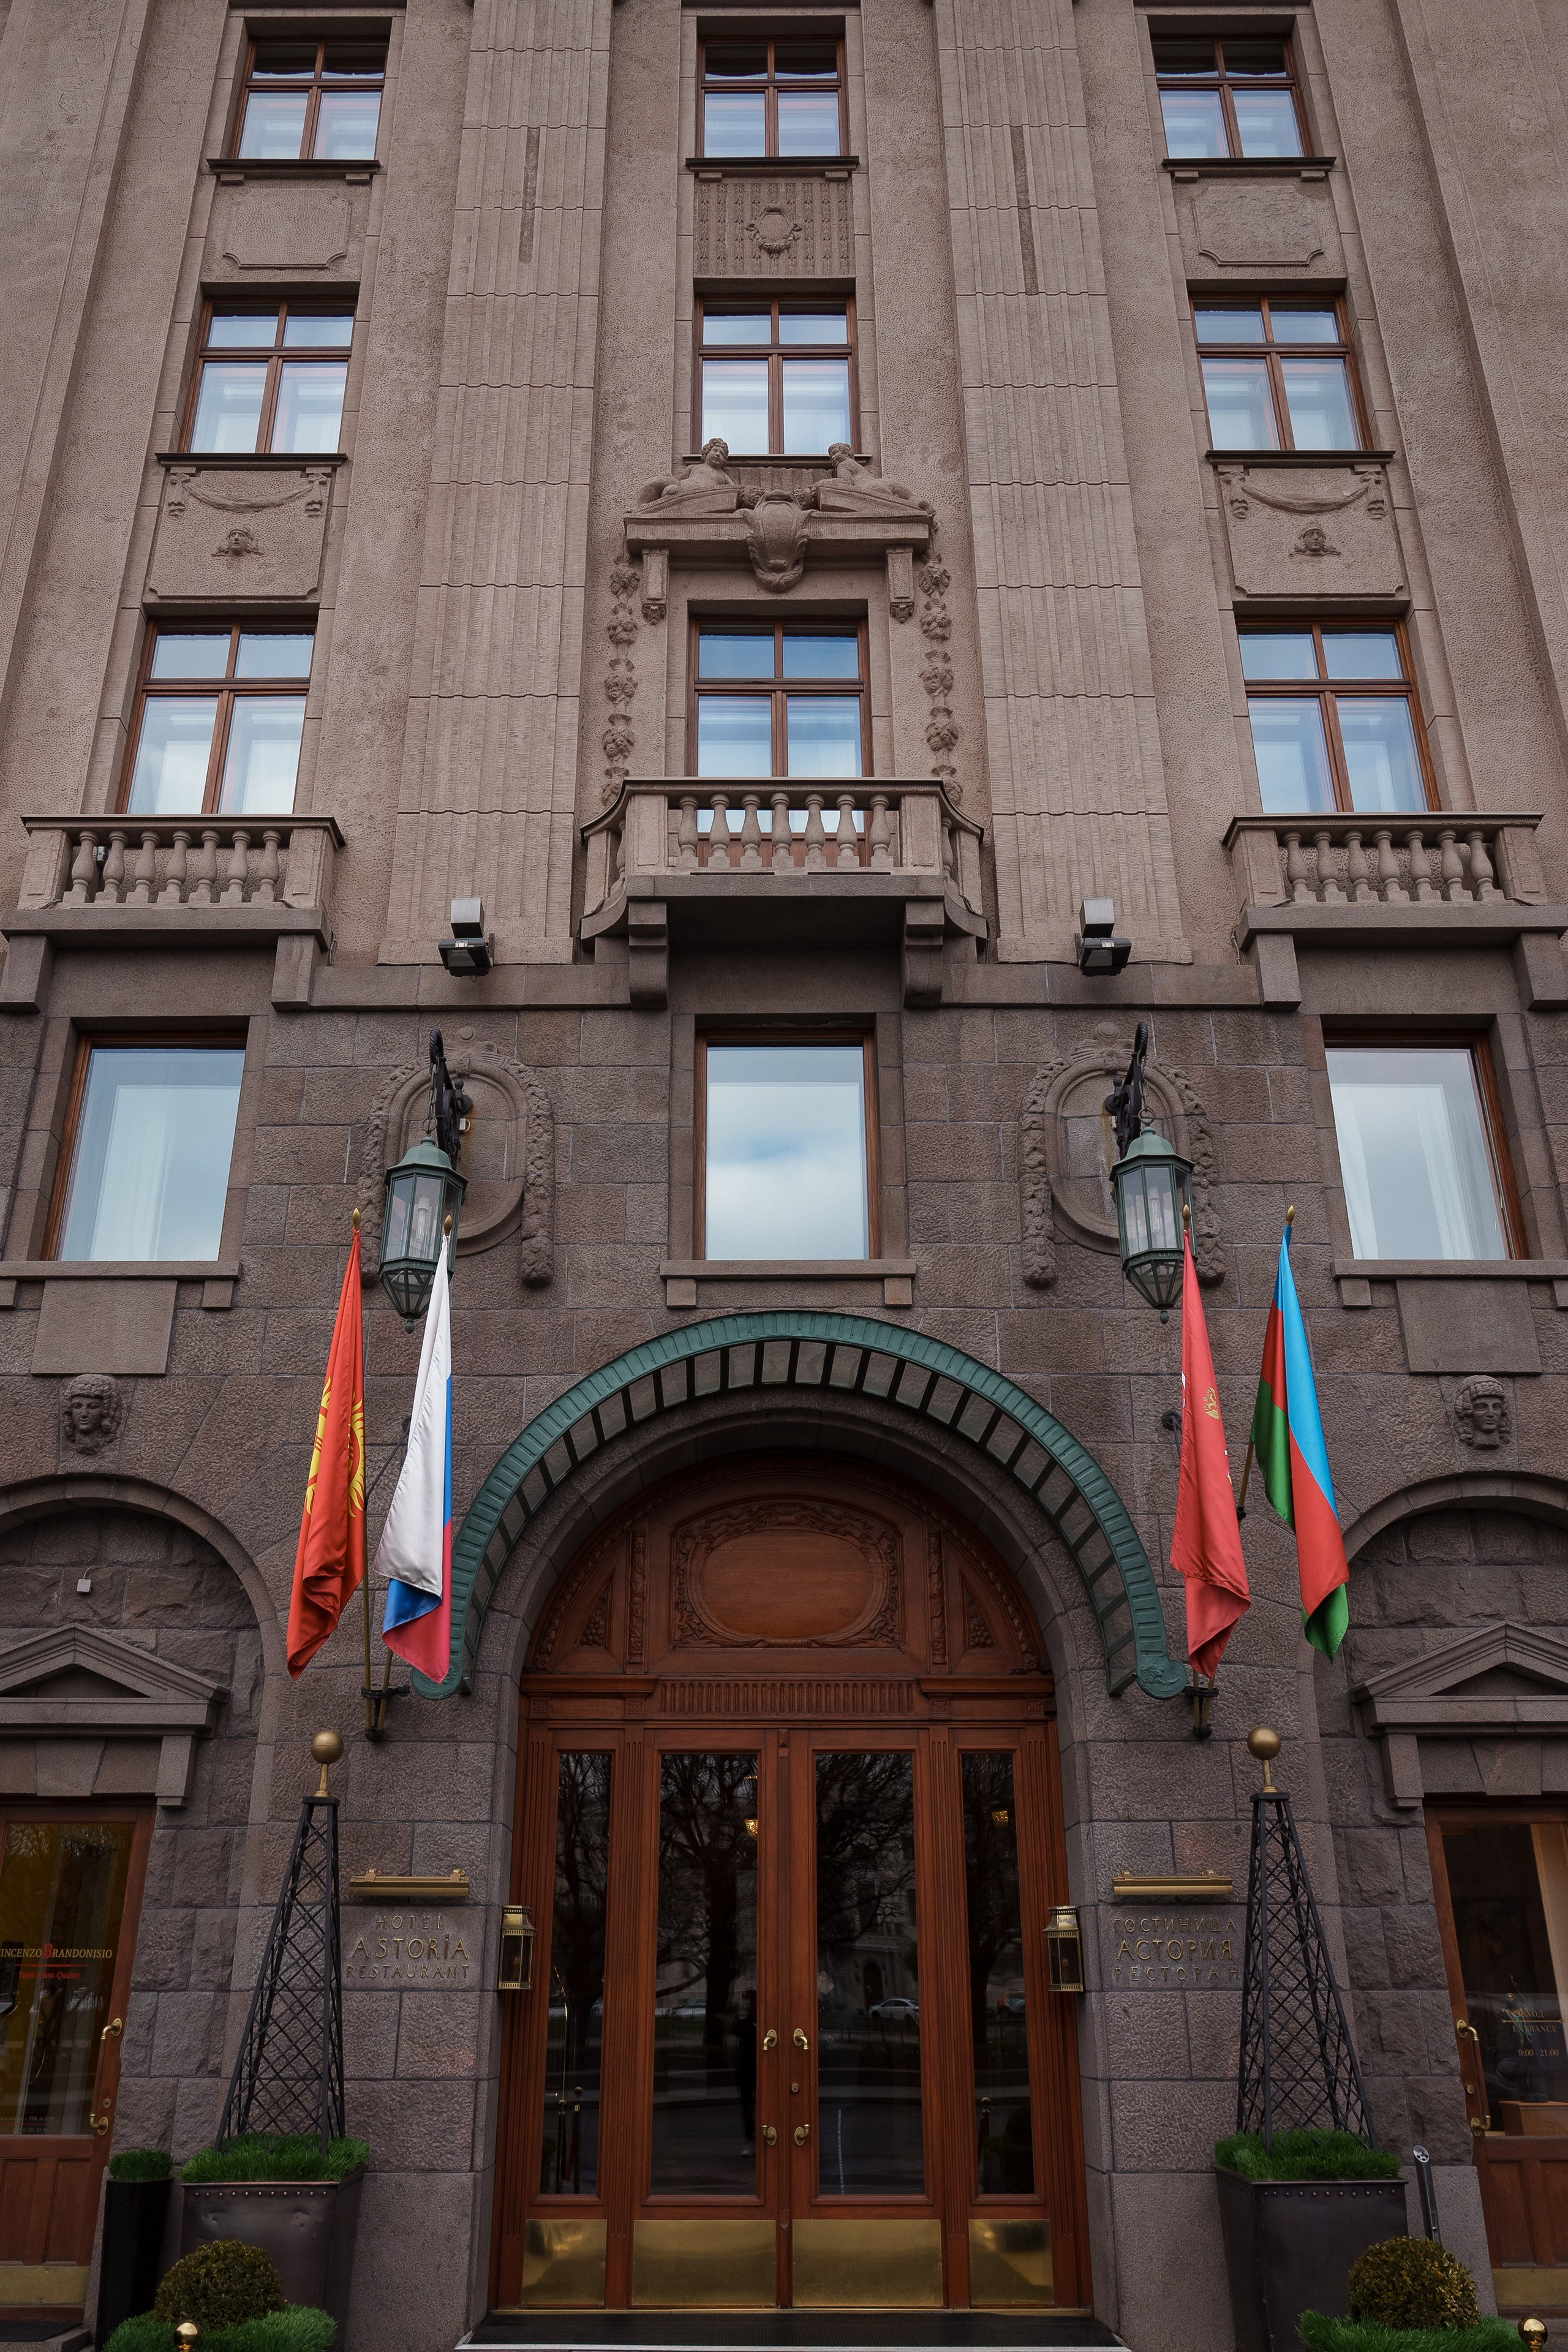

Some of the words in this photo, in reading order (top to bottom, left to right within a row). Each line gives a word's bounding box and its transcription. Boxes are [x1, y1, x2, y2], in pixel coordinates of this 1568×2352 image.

[375, 1915, 445, 1930] HOTEL
[1113, 1918, 1237, 1933] ГОСТИНИЦА
[0, 1948, 42, 1958] INCENZO
[43, 1943, 112, 1958] BRANDONISIO
[1117, 1938, 1232, 1961] АСТОРИЯ
[346, 1964, 470, 1979] RESTAURANT
[1115, 1966, 1238, 1981] РЕСТОРАН
[1521, 2010, 1544, 2018] ВХОД
